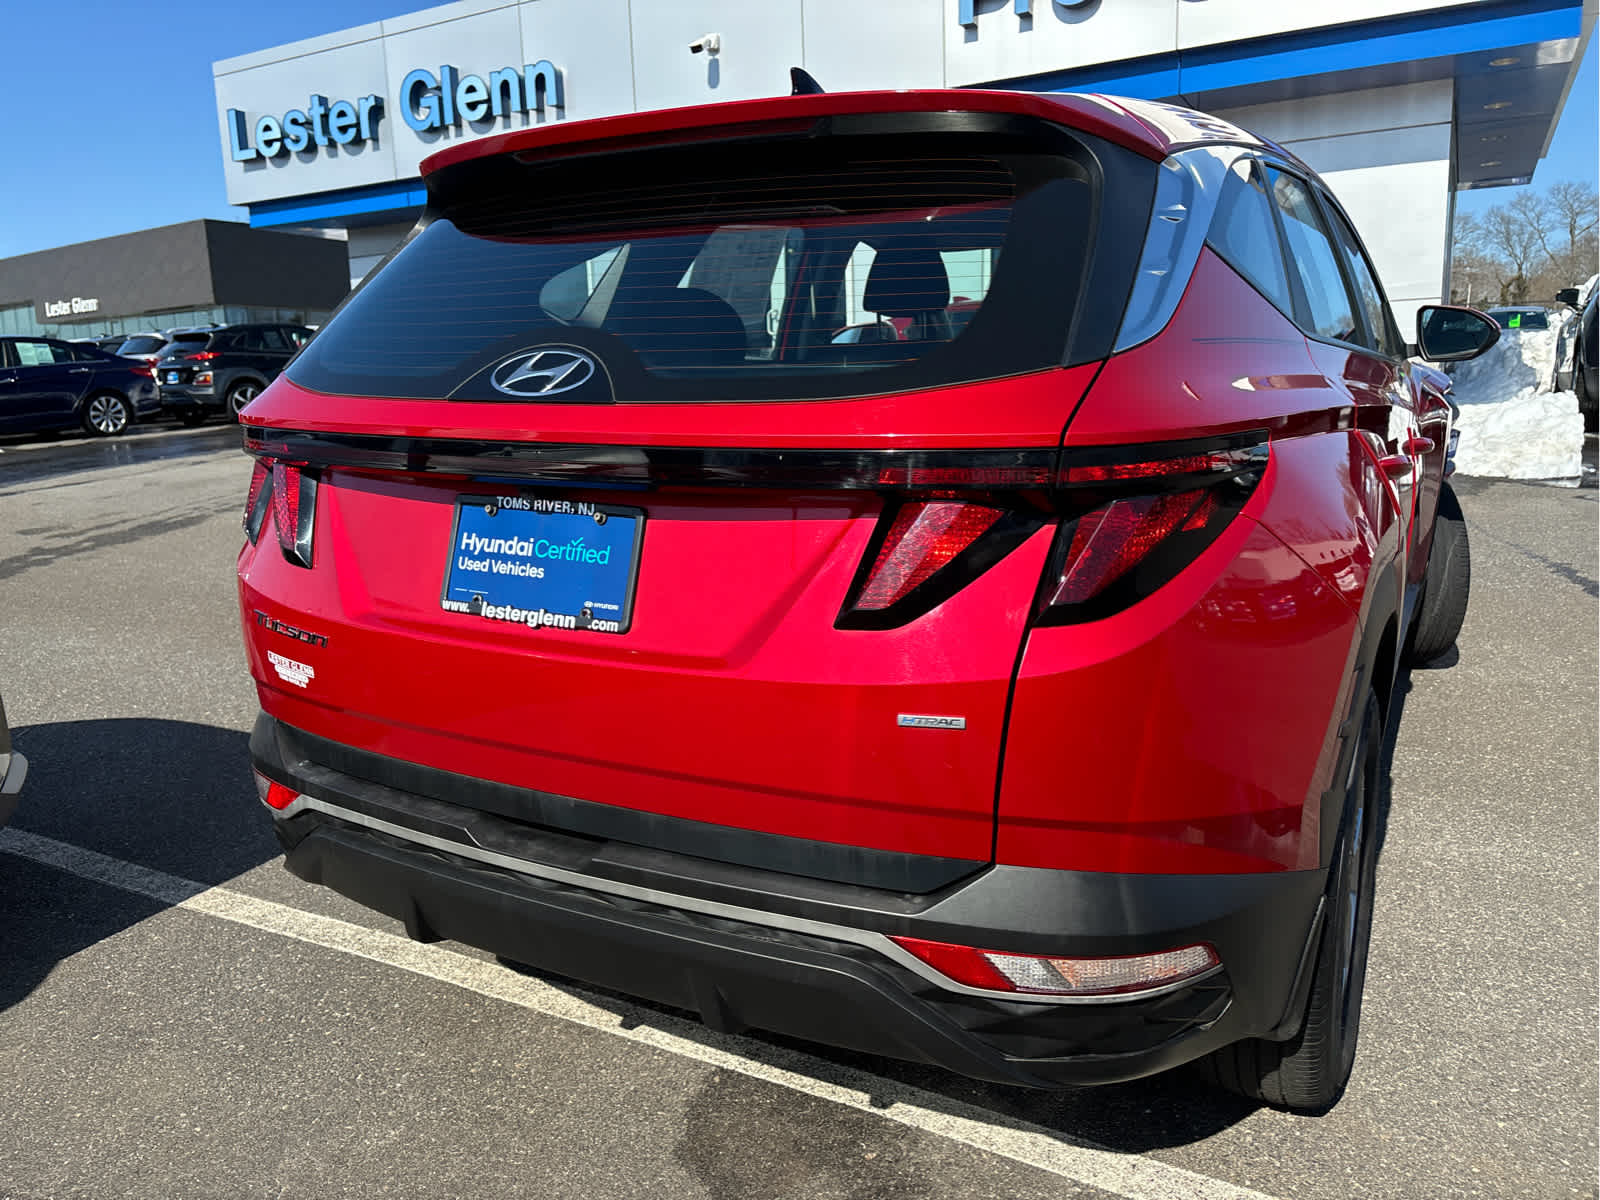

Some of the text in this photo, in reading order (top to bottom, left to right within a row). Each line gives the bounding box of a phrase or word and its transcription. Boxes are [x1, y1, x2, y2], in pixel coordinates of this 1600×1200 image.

[227, 60, 565, 162] Lester Glenn
[45, 297, 98, 317] Lester Glenn
[496, 496, 595, 516] TOMS RIVER, NJ
[461, 532, 610, 565] Hyundai Certified
[458, 556, 544, 578] Used Vehicles
[481, 601, 576, 628] lesterglenn
[902, 717, 961, 727] HTRAC
